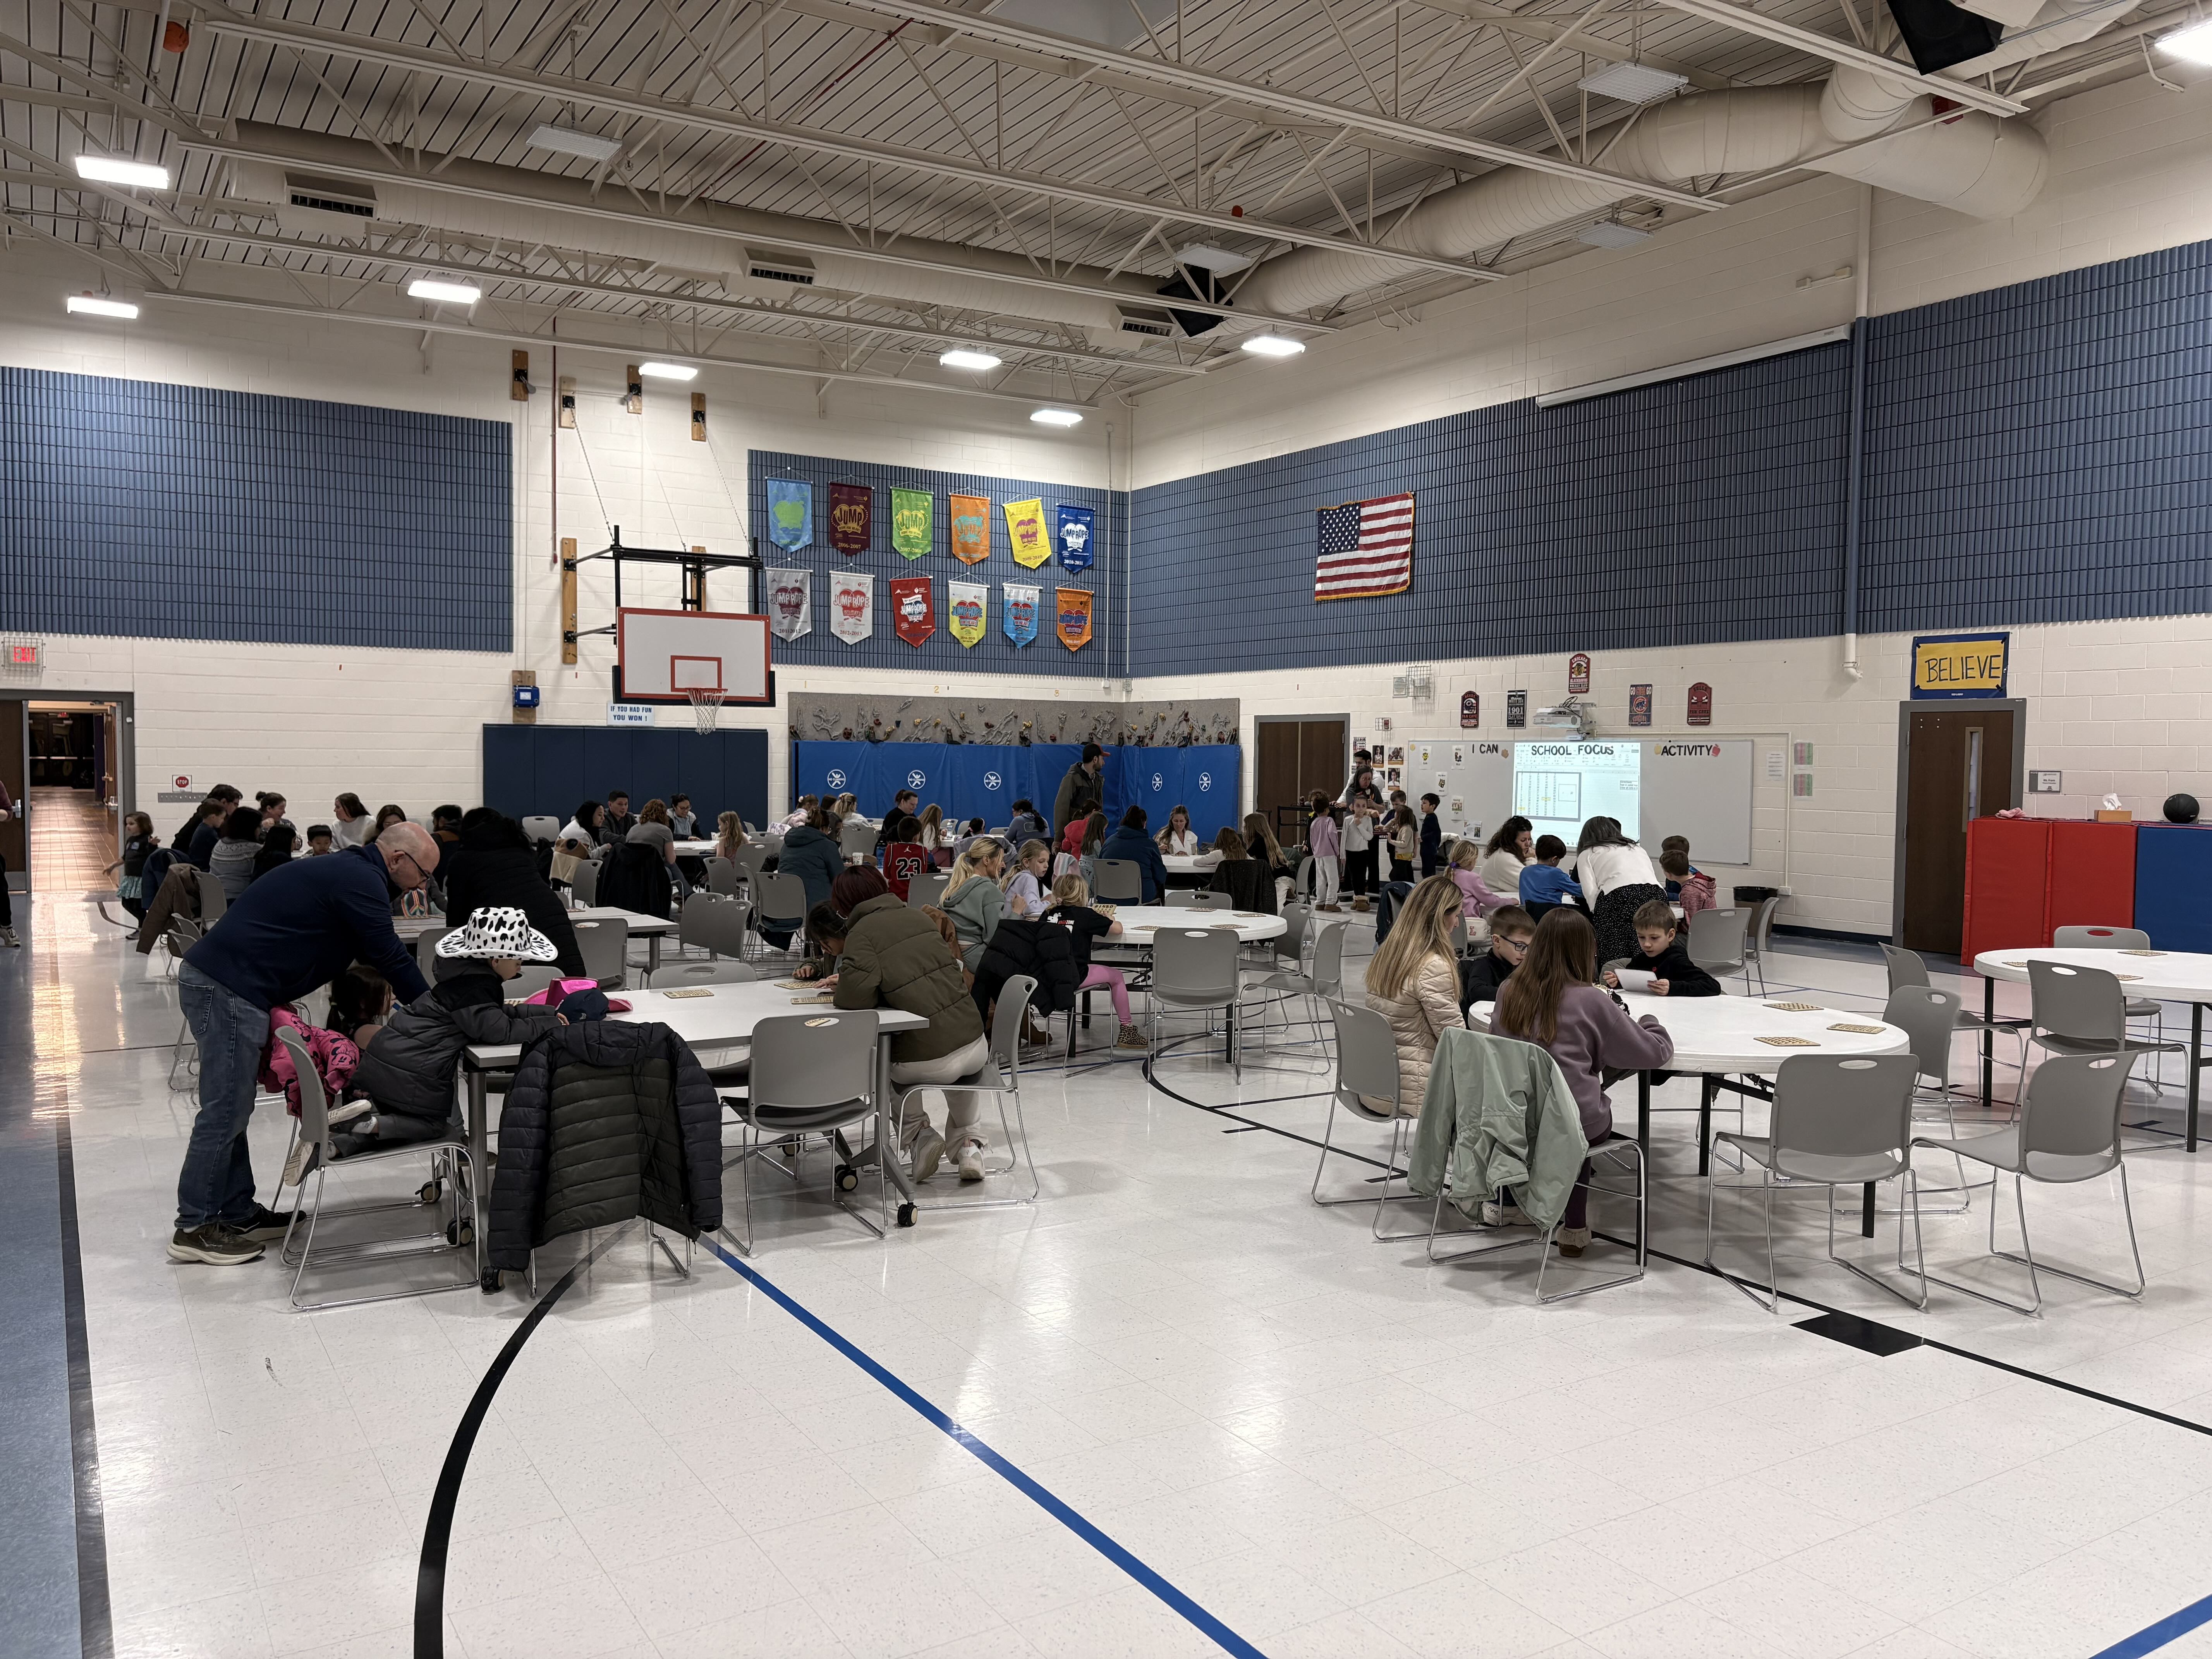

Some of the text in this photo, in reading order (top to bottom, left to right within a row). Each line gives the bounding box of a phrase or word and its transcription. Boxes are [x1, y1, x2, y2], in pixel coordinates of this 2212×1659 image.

[837, 507, 862, 526] JUMP
[900, 512, 922, 531] JUMP
[1013, 523, 1042, 536] JUMP ROPE
[1060, 528, 1089, 539] JUMP ROPE
[770, 592, 808, 605] JUMP ROPE
[834, 595, 870, 607] JUMP ROPE
[901, 604, 927, 615] JUMP ROPE
[951, 606, 982, 617] JUMP ROPE
[1006, 607, 1021, 617] JUMP
[14, 647, 36, 663] EXIT
[1925, 655, 2001, 682] BELIEVE
[1472, 744, 1498, 754] I CAN
[1531, 745, 1571, 755] SCHOOL
[1578, 744, 1614, 755] FOCUS
[1661, 745, 1712, 756] ACTIVITY
[896, 857, 921, 880] 23
[1469, 926, 1476, 936] L
